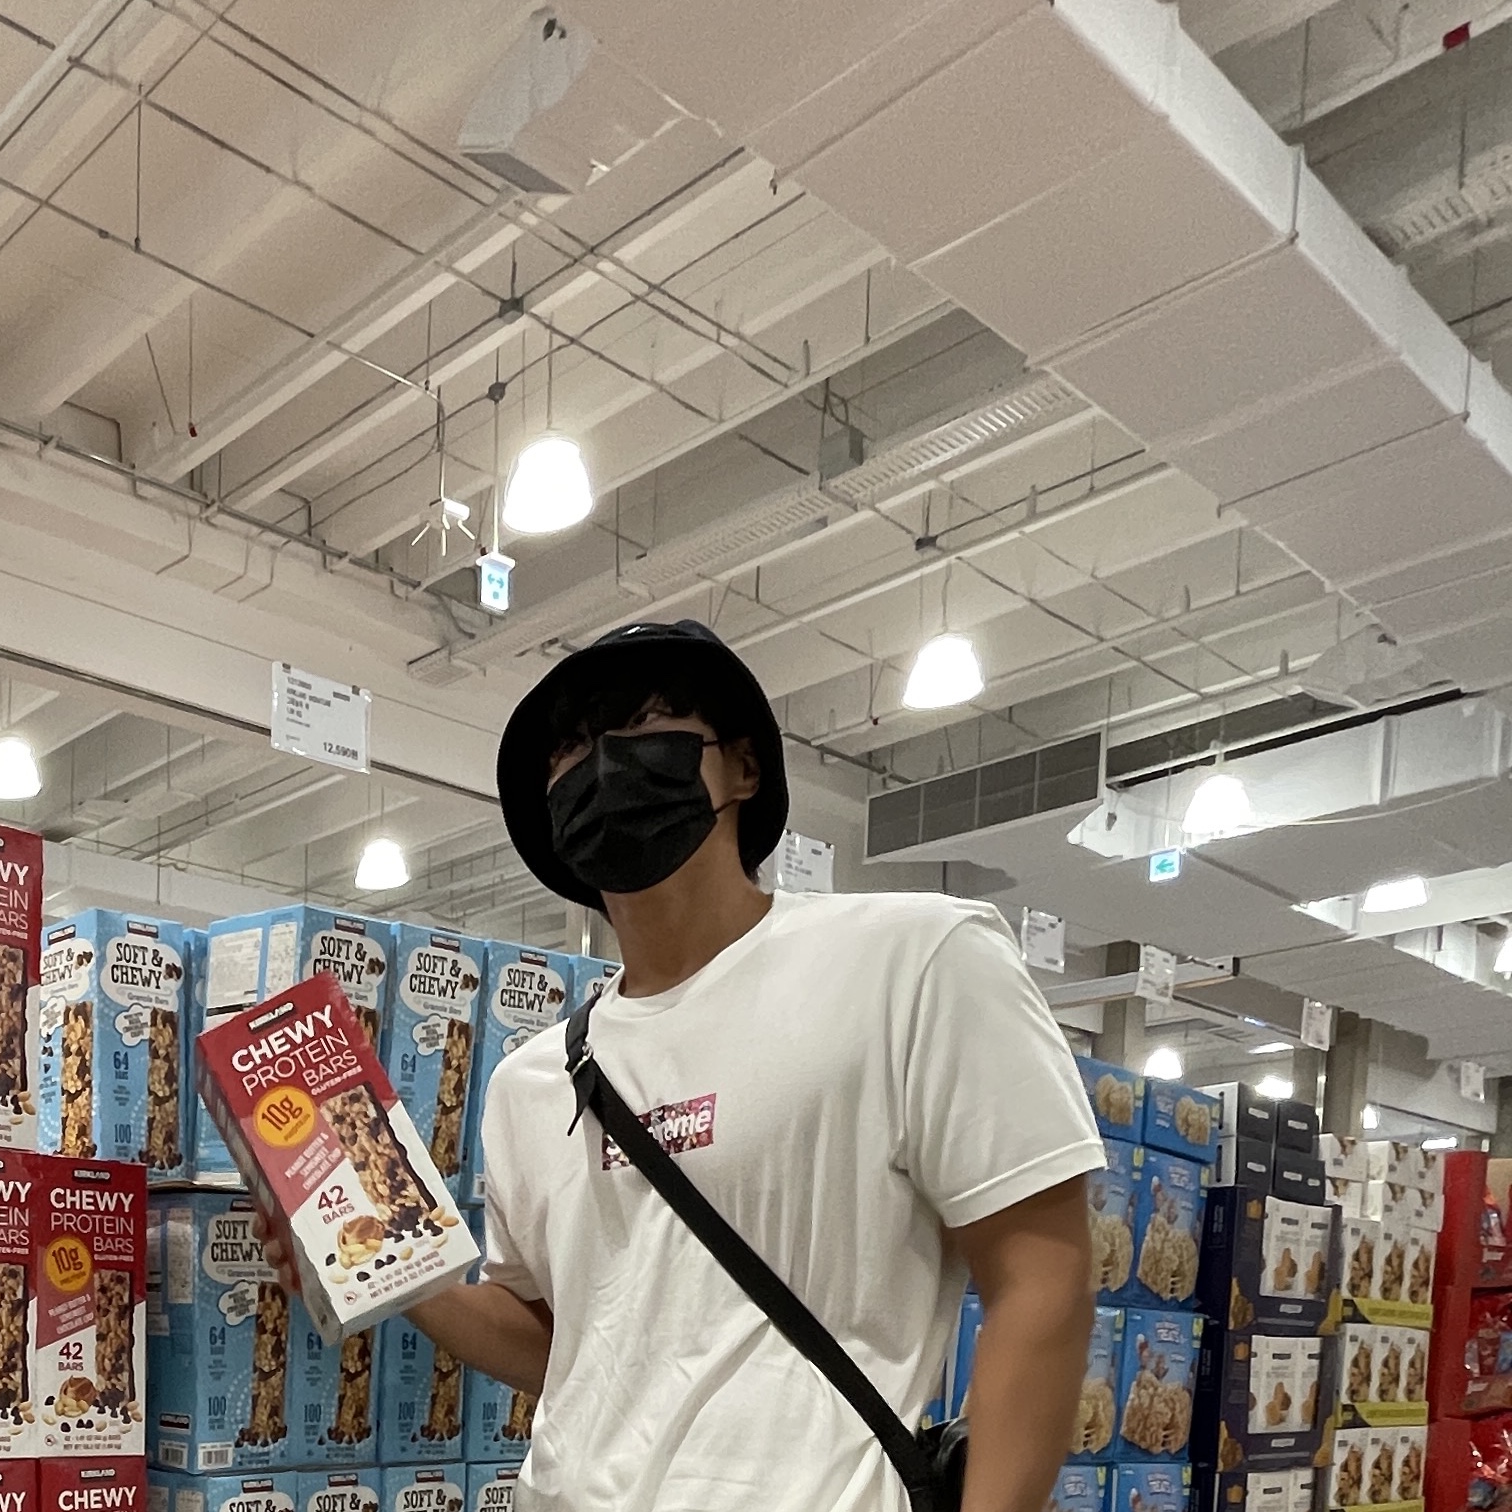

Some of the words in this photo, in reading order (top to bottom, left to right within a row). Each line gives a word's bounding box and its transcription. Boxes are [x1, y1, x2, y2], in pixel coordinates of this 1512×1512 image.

[117, 944, 147, 966] SOFT
[151, 949, 162, 967] &
[416, 953, 448, 976] SOFT
[450, 959, 461, 978] &
[112, 965, 160, 988] CHEWY
[410, 974, 459, 999] CHEWY
[506, 969, 535, 990] SOFT
[538, 974, 548, 992] &
[500, 989, 545, 1013] CHEWY
[249, 1003, 293, 1029] KIRKLAND
[233, 1005, 332, 1071] CHEWY
[113, 1051, 129, 1070] 64
[243, 1029, 348, 1095] PROTEIN
[303, 1050, 357, 1086] BARS
[401, 1052, 416, 1072] 64
[312, 1066, 363, 1094] GLUTEN-FREE
[262, 1095, 303, 1131] 10g
[114, 1124, 131, 1144] 100
[52, 1188, 134, 1212] CHEWY
[318, 1185, 349, 1210] 42
[53, 1212, 133, 1235] PROTEIN
[322, 1203, 355, 1224] BARS
[94, 1237, 133, 1253] BARS
[52, 1247, 82, 1273] 10g
[59, 1342, 82, 1360] 42
[59, 1363, 83, 1371] BARS
[404, 1489, 433, 1509] SOFT
[436, 1489, 446, 1505] &
